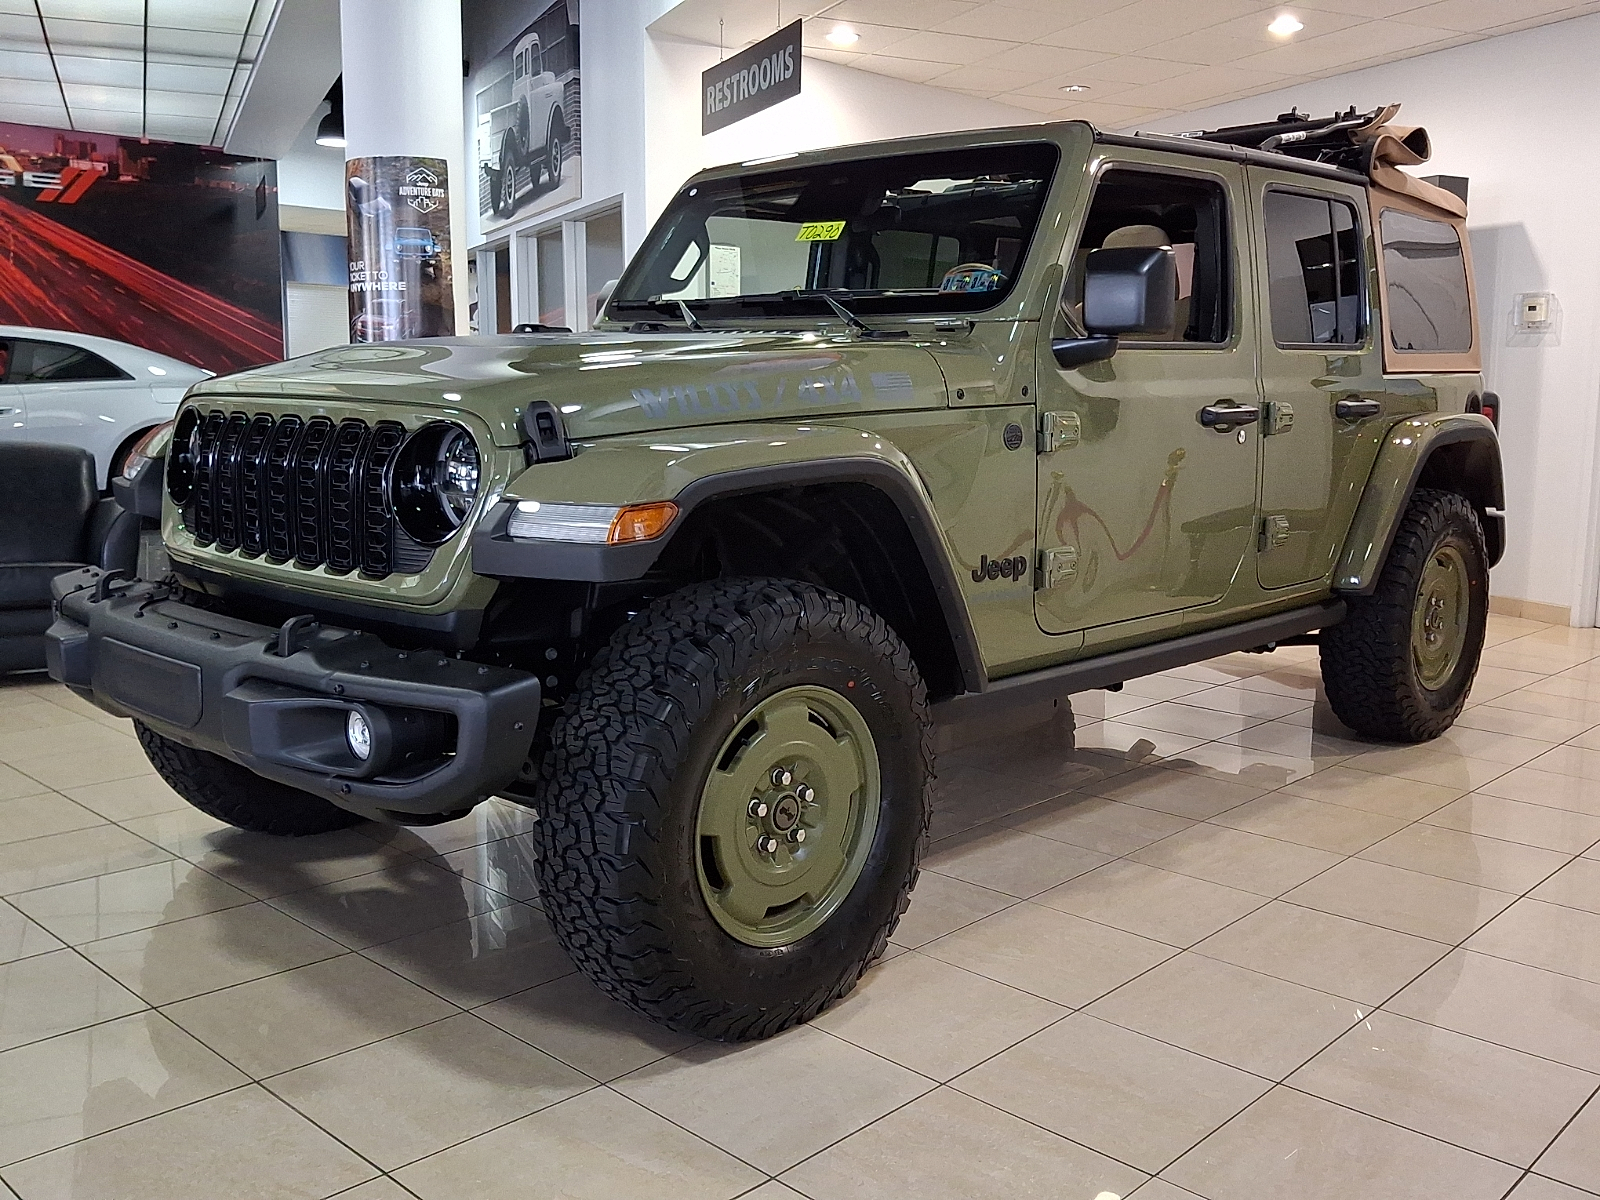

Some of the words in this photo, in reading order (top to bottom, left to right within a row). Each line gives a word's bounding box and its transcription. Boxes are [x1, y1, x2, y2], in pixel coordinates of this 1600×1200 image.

[706, 44, 794, 115] RESTROOMS
[349, 260, 365, 272] OUR
[372, 270, 388, 280] TO
[631, 379, 762, 419] WILLYS
[971, 554, 1027, 583] Jeep
